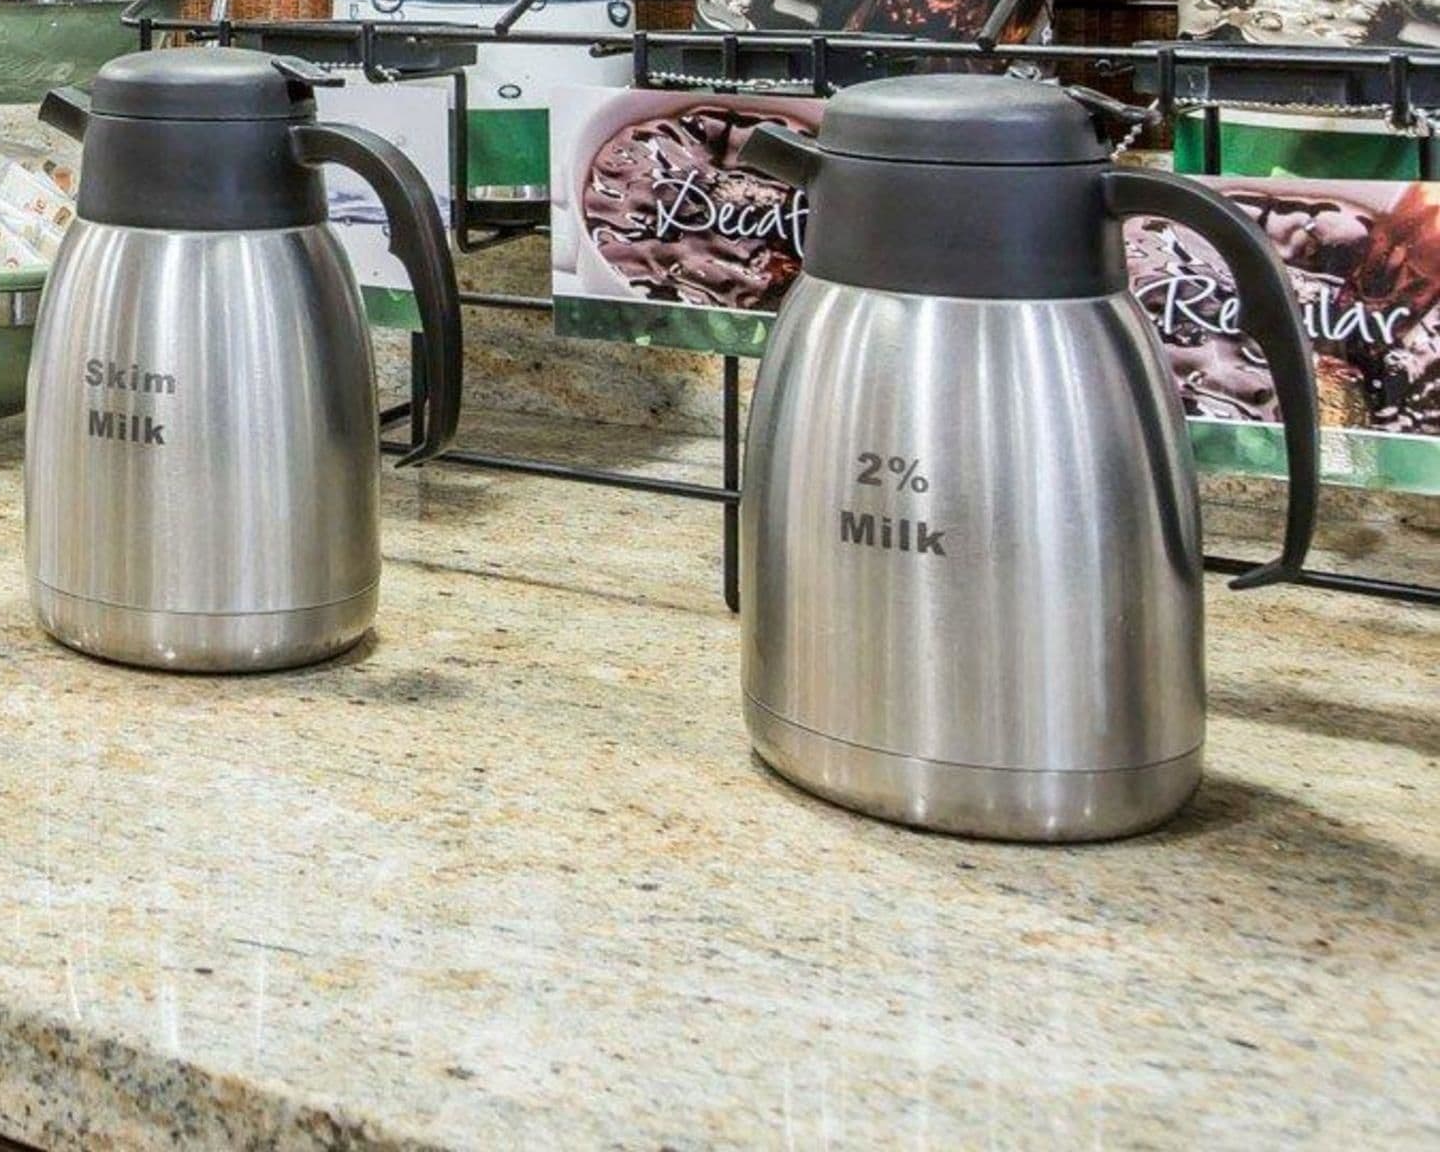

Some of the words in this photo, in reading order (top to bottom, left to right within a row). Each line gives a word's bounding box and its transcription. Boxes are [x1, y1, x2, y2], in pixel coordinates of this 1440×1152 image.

[652, 170, 809, 257] Decaf
[85, 358, 176, 395] Skim
[88, 410, 165, 445] Milk
[856, 452, 929, 493] 2%
[840, 510, 947, 556] Milk
